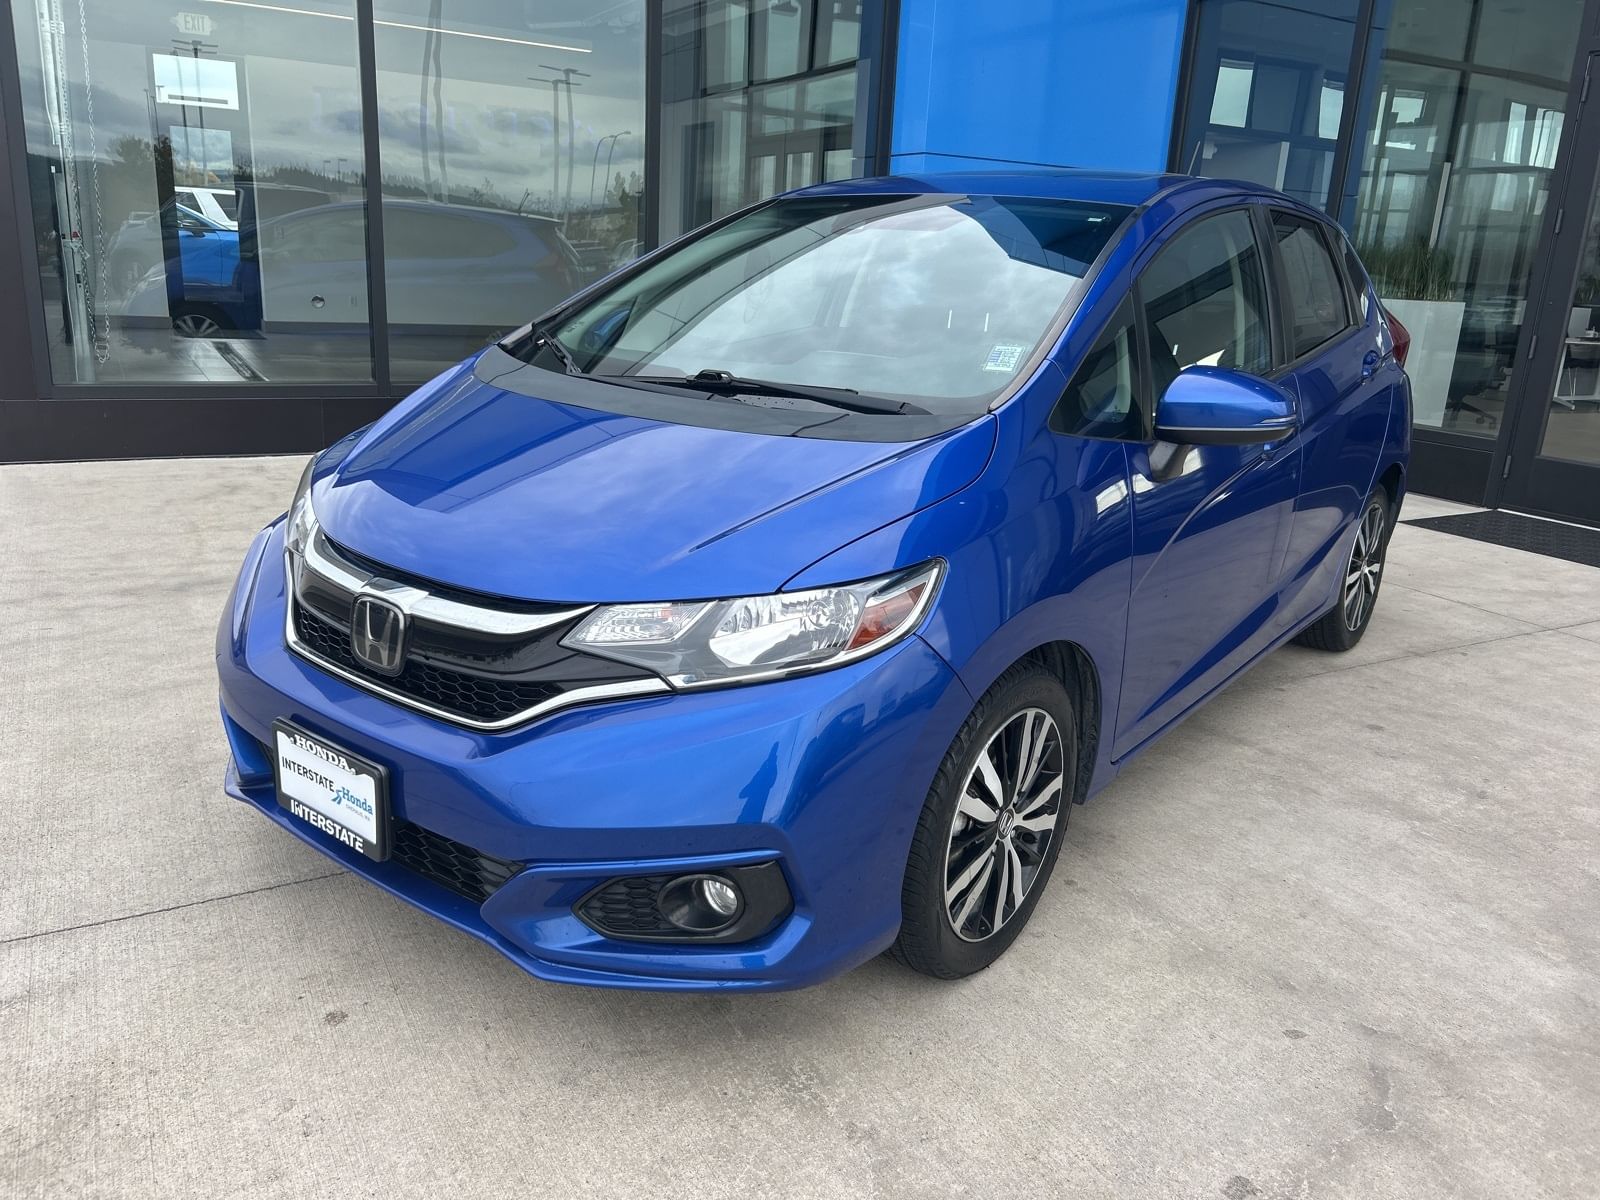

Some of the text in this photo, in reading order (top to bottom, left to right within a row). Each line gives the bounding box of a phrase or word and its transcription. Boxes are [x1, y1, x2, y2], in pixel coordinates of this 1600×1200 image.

[183, 14, 205, 32] EXIT
[292, 734, 351, 772] HONDA
[281, 756, 336, 793] INTERSTATE
[341, 786, 374, 815] Honda
[290, 799, 365, 854] INTERSTATE
